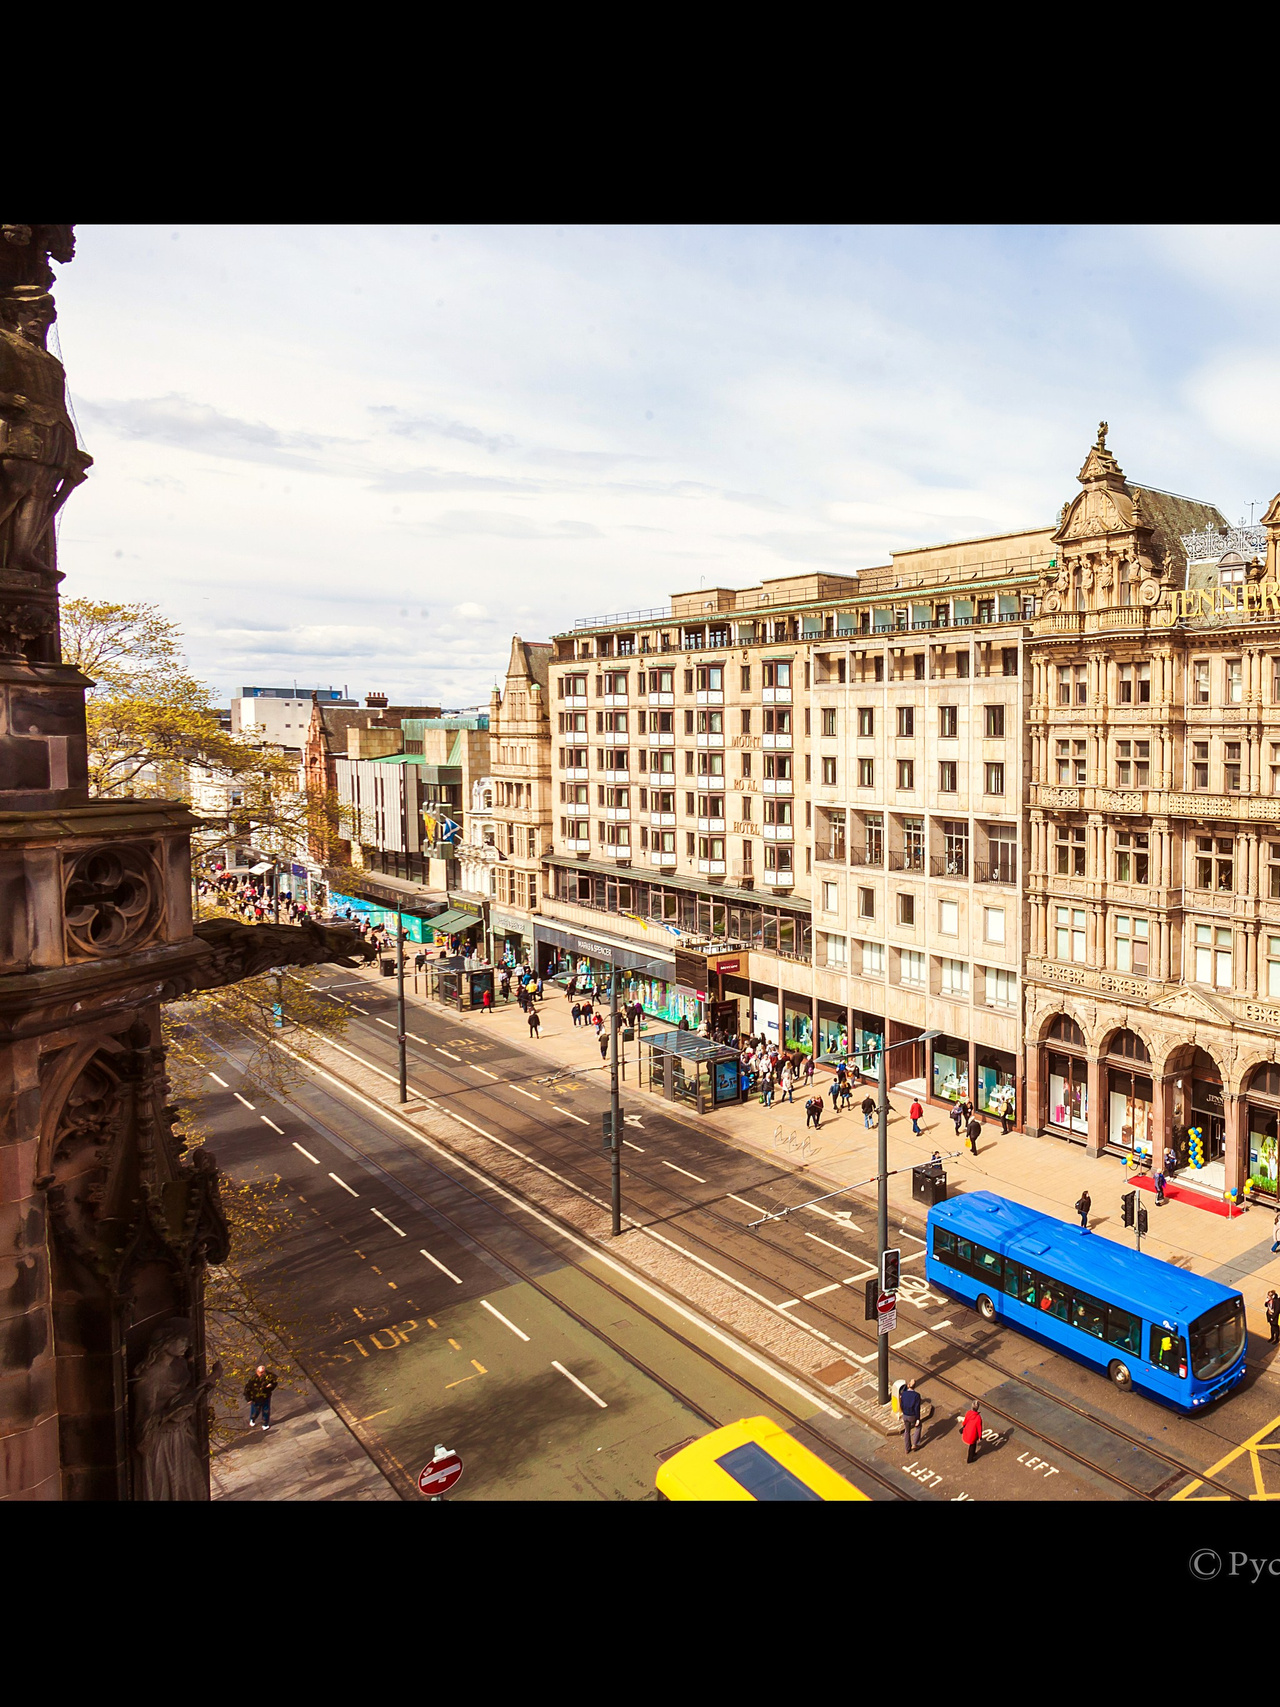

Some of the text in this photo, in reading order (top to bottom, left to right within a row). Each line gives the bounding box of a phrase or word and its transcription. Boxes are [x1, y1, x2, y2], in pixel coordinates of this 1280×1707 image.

[731, 735, 761, 748] MOUNT
[733, 778, 758, 792] ROAL
[733, 820, 760, 836] HOTEL
[1206, 1094, 1224, 1104] JENN
[1016, 1451, 1060, 1478] LEFT
[901, 1461, 943, 1488] LEFT
